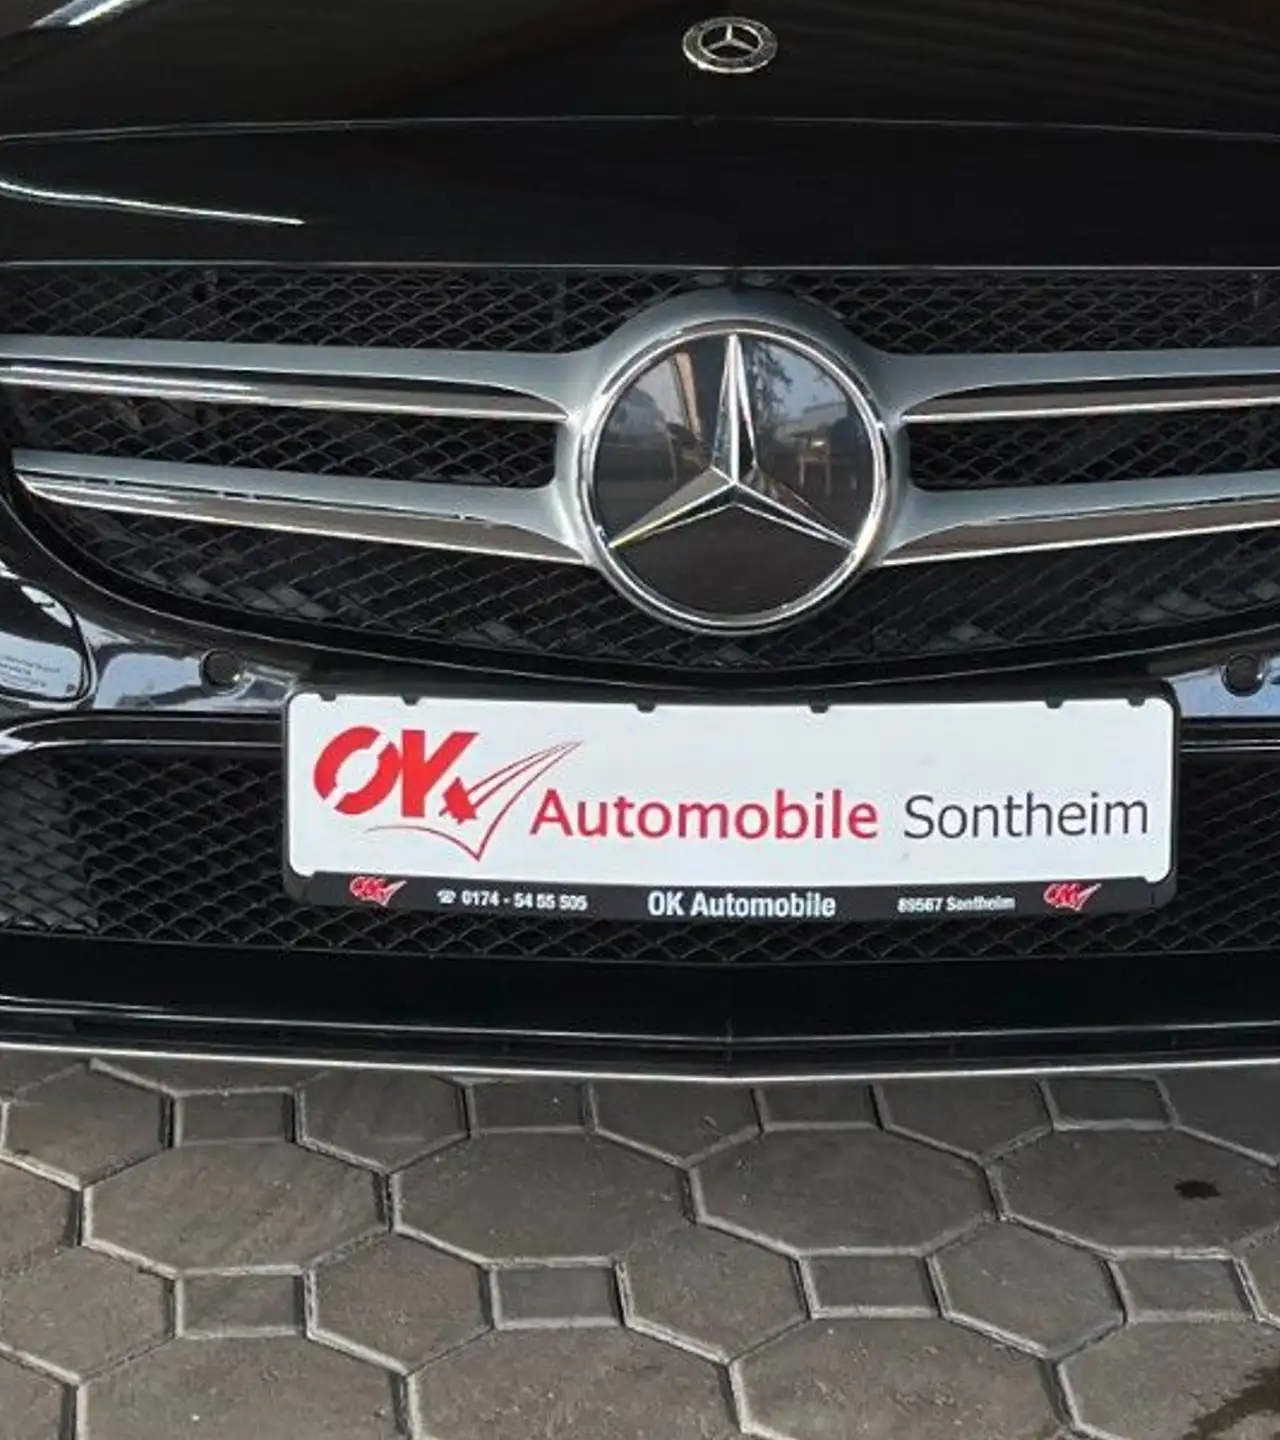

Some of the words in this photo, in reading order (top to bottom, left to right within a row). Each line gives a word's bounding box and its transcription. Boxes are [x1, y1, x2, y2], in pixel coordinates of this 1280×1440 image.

[313, 726, 480, 822] OK
[529, 788, 879, 839] Automobile
[904, 791, 1149, 839] Sontheim
[461, 889, 500, 907] 0174
[647, 890, 685, 916] OK
[690, 891, 837, 918] Automobile
[946, 895, 1016, 911] Sontheim
